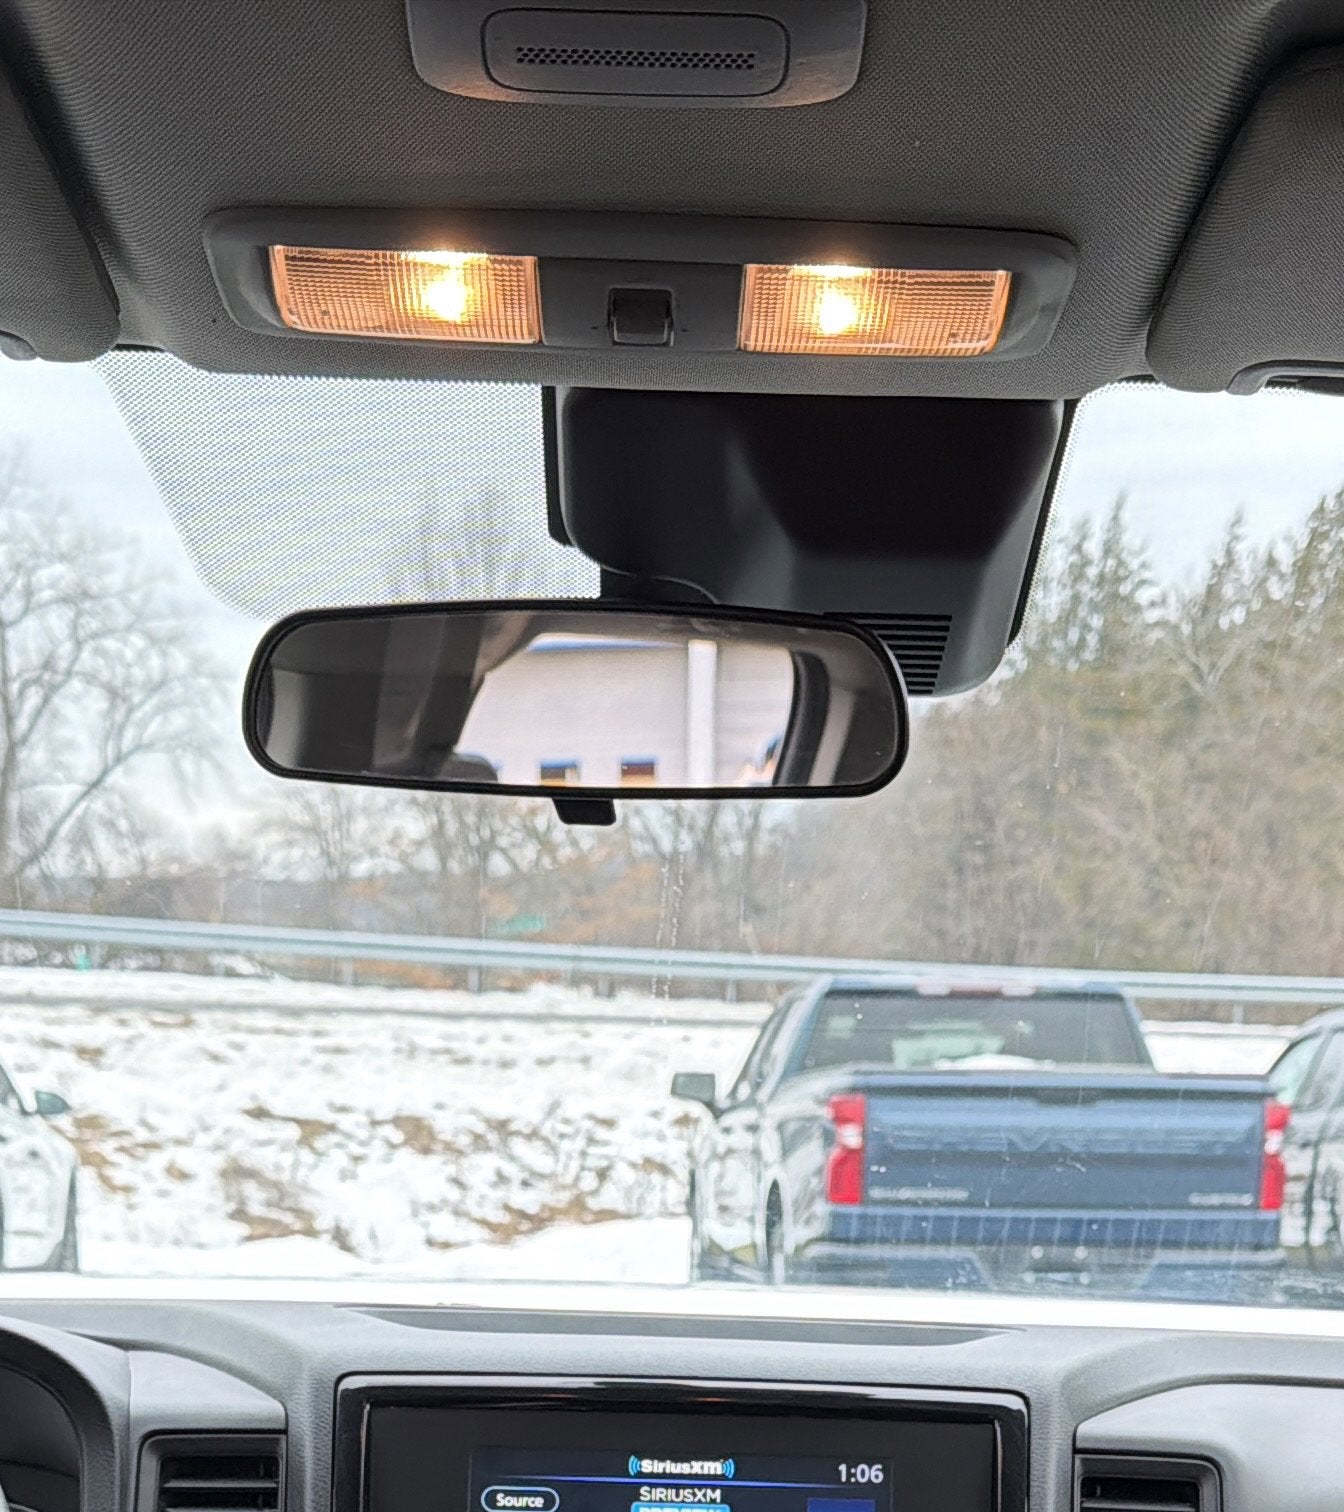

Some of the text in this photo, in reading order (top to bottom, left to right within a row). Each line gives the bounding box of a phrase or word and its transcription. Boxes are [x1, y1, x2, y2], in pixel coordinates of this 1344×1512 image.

[838, 1464, 884, 1484] 1:06
[496, 1493, 544, 1508] Source
[639, 1486, 721, 1503] SIRIUSXM
